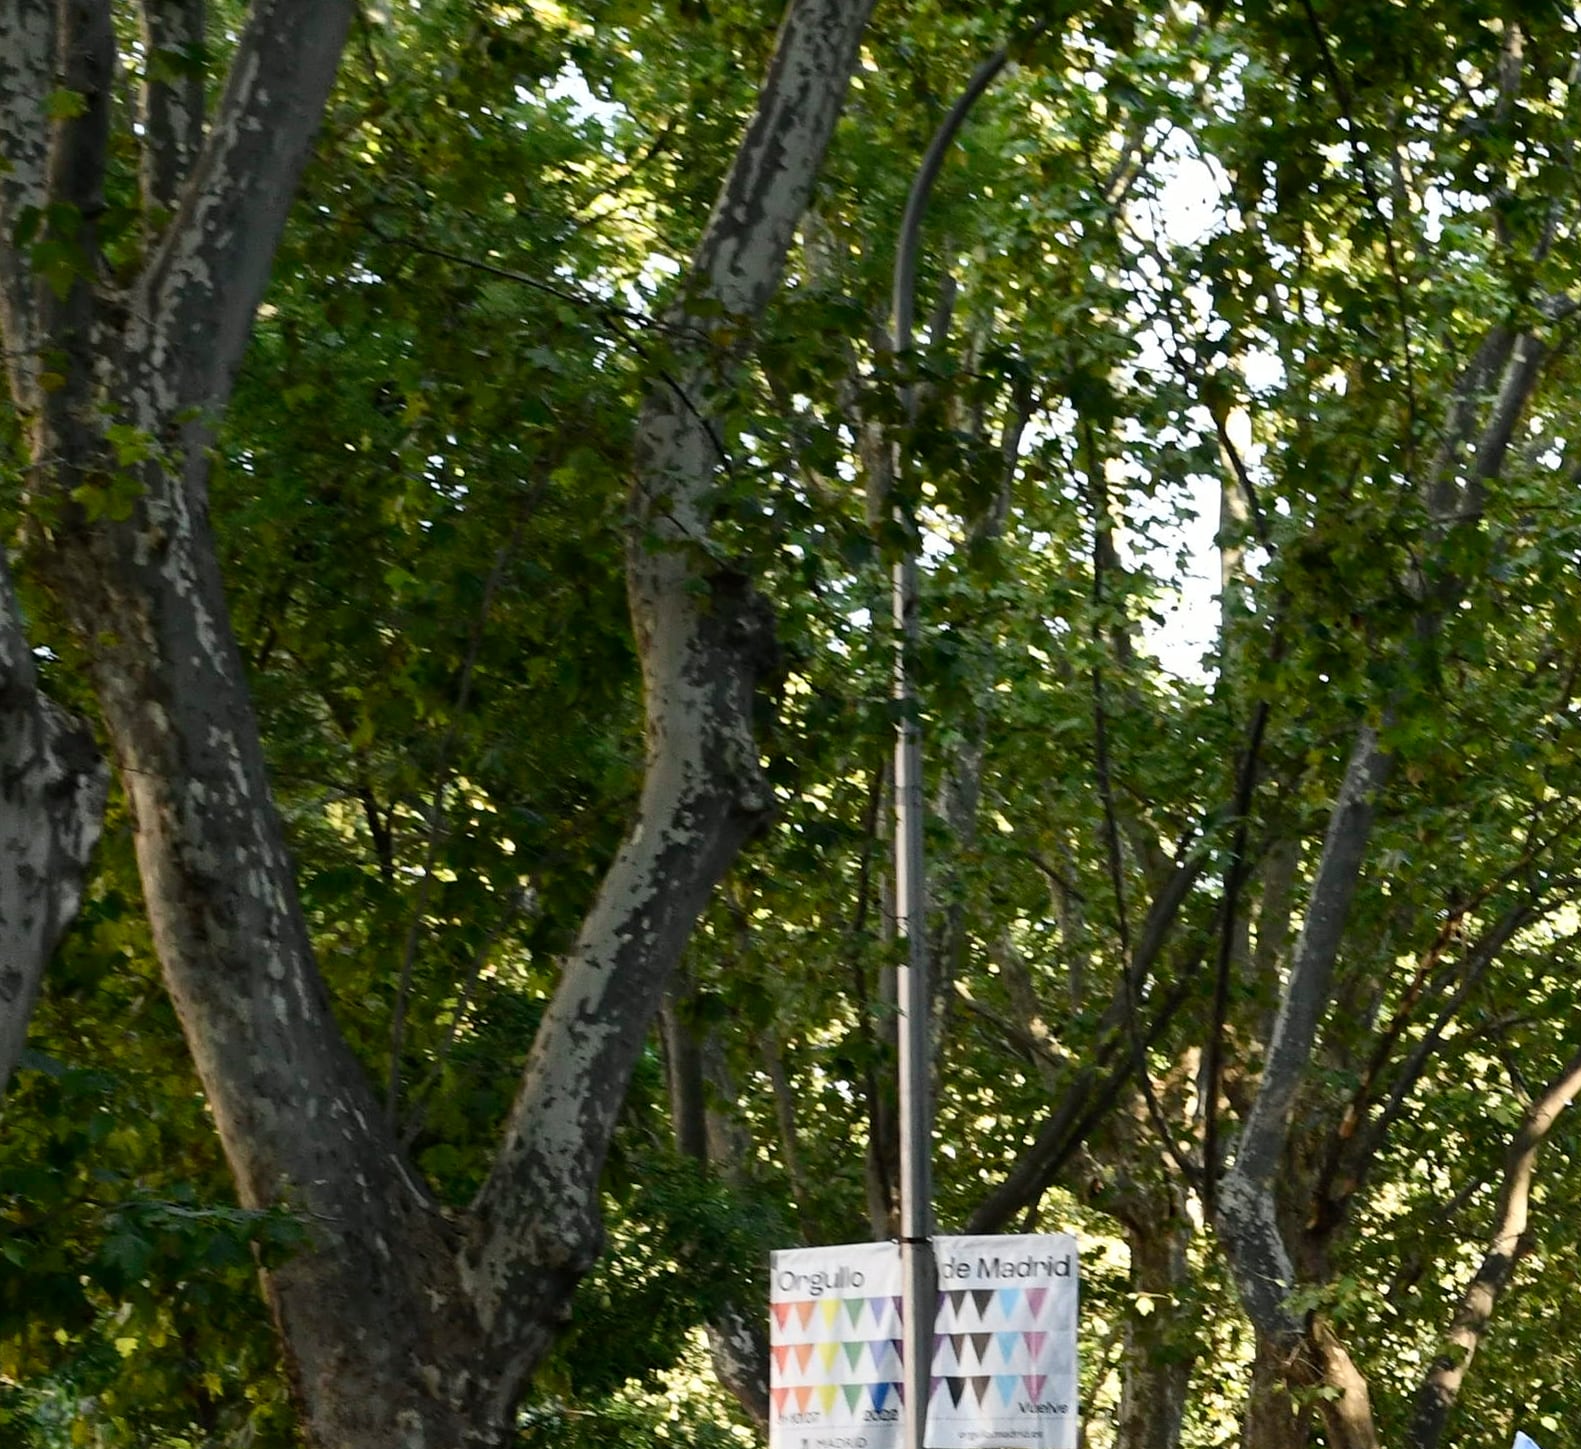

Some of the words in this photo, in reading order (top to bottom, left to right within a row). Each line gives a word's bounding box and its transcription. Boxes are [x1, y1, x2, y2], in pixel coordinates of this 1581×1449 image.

[943, 1257, 970, 1279] de
[977, 1254, 1071, 1279] Madrid
[777, 1267, 865, 1297] Orgullo
